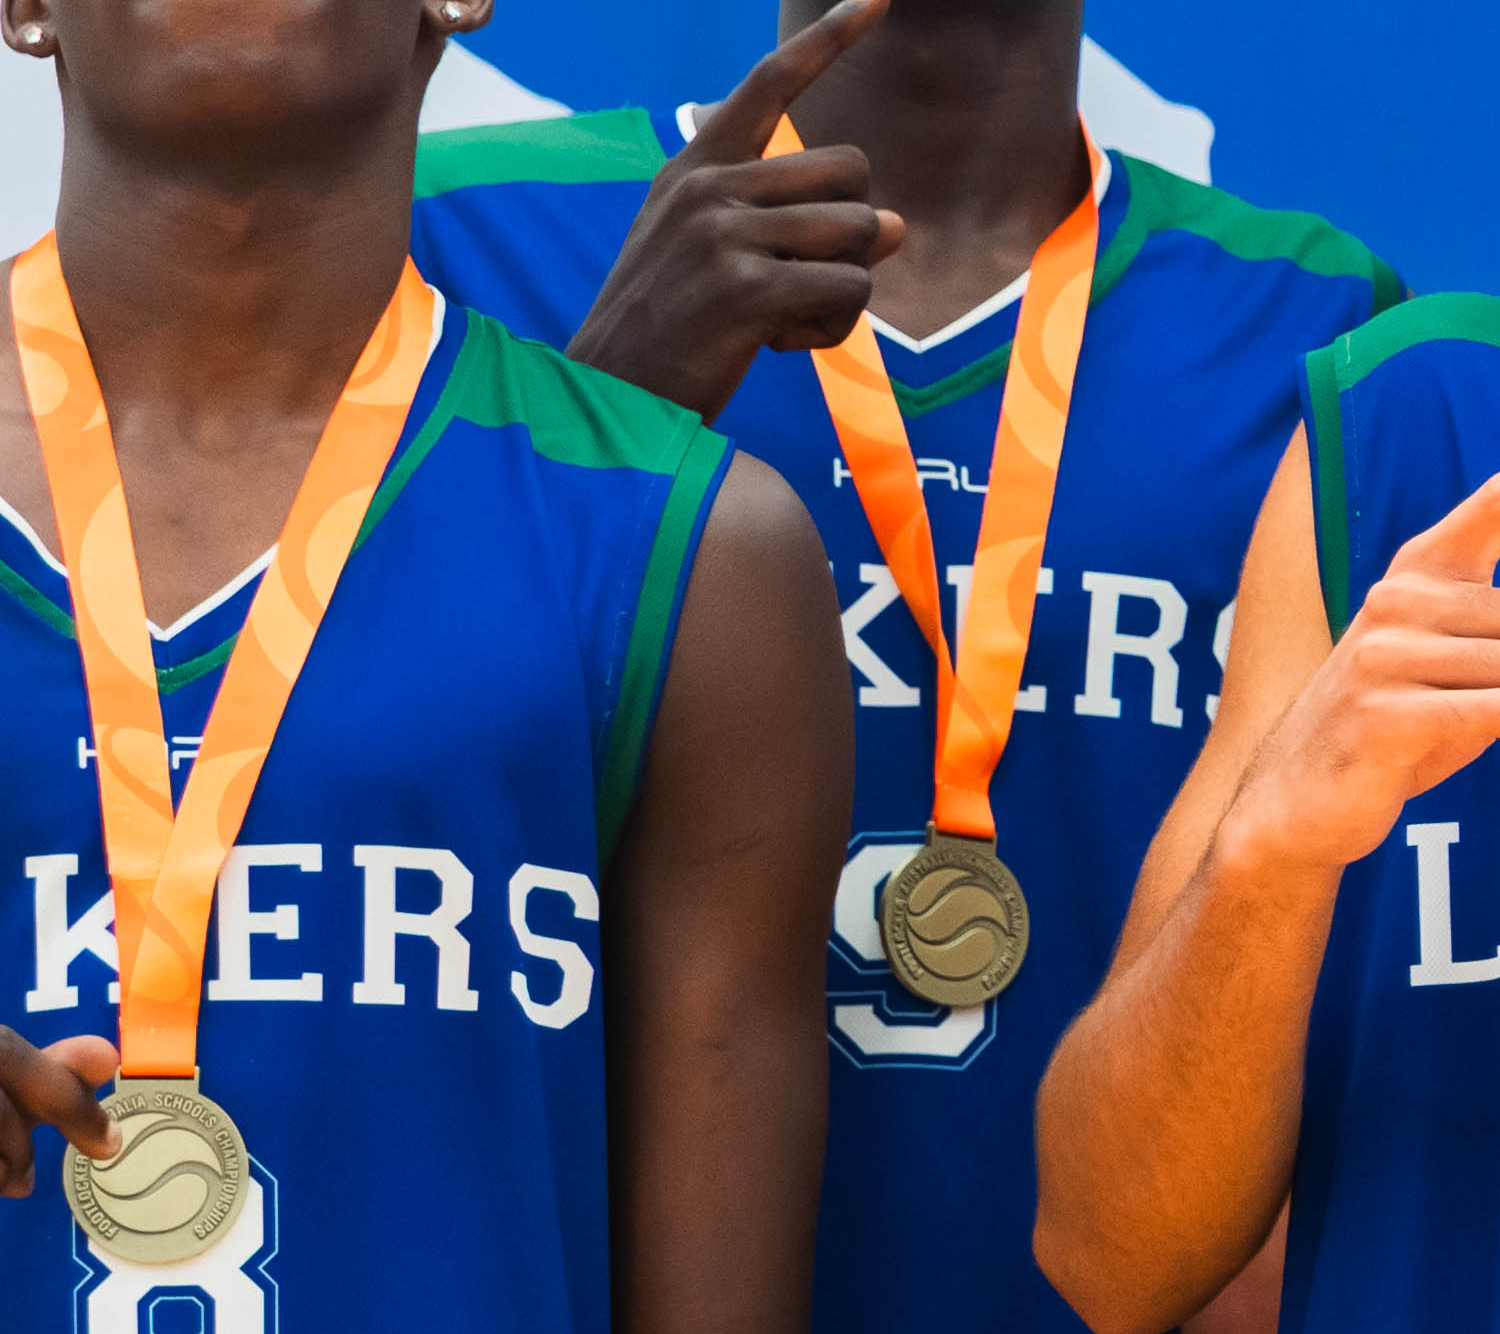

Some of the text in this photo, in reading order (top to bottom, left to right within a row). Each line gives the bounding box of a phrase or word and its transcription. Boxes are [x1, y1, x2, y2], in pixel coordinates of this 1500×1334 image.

[74, 1092, 240, 1240] FOOTLOCKER RALIA SCHOOLS CHAMPIONSHIPS
